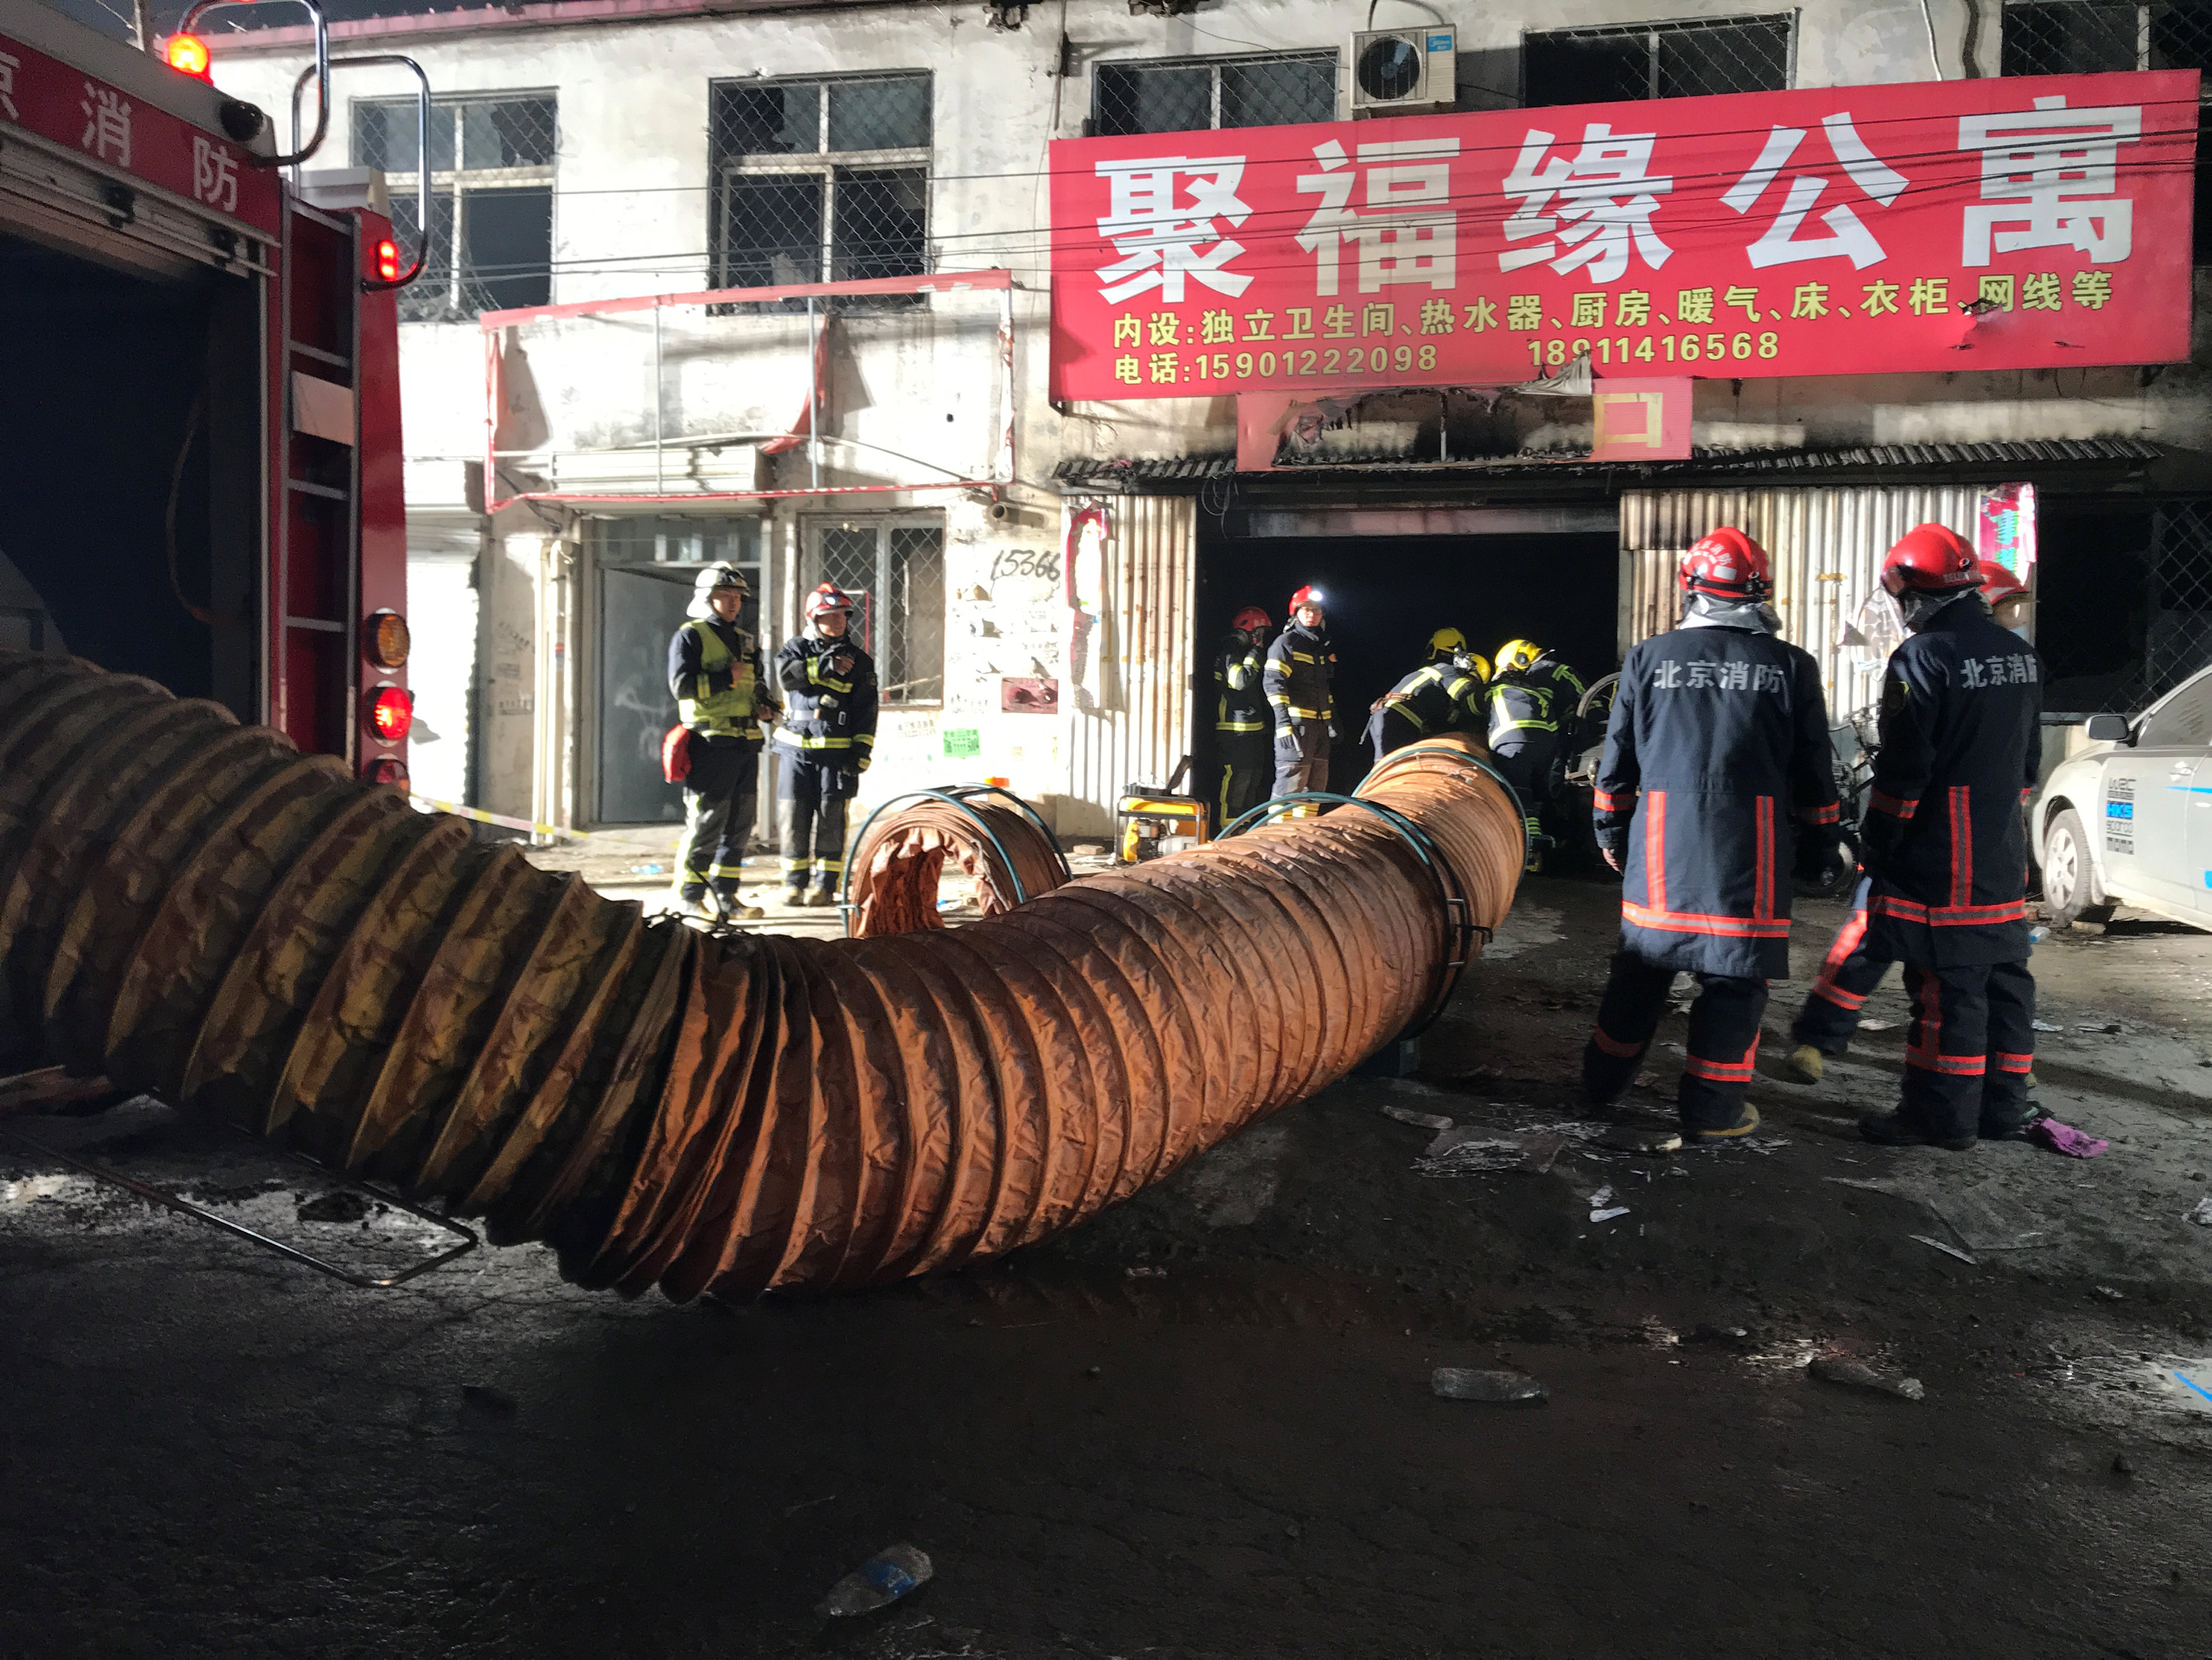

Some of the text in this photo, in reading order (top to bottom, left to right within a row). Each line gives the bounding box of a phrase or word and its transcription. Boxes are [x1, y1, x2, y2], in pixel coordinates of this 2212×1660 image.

[1095, 95, 2143, 305] 聚福缘公寓
[1114, 332, 1779, 386] 电话:15901222098 18911416568
[1653, 659, 1784, 693] 北京消防
[2106, 802, 2133, 819] HKS
